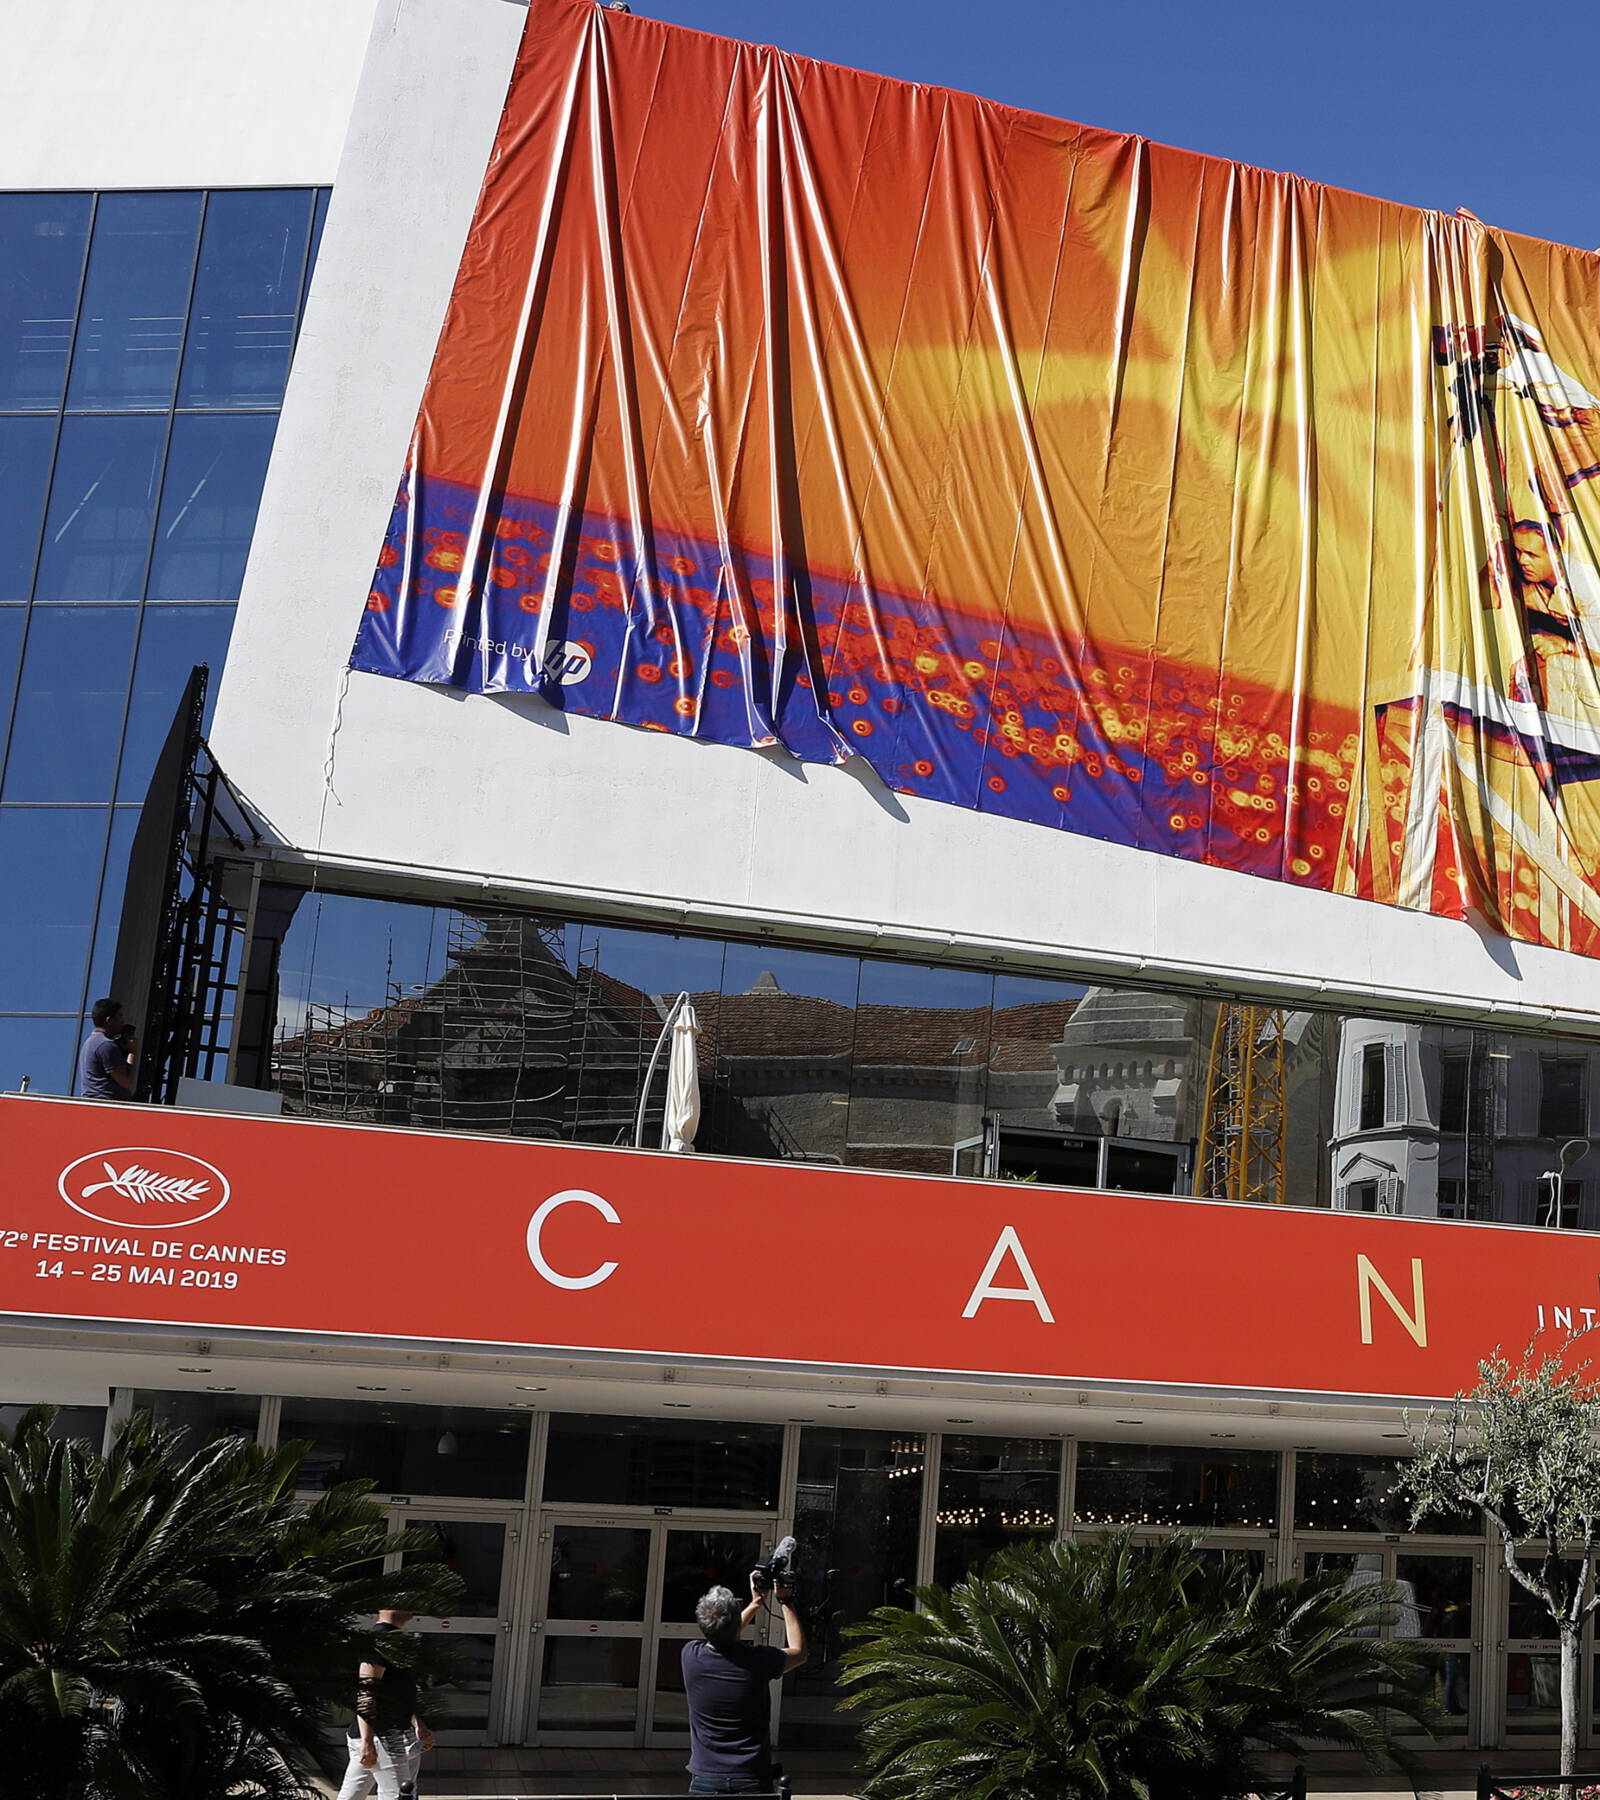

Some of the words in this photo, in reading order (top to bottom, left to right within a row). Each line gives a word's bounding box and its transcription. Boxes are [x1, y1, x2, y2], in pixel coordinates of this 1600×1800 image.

[443, 629, 507, 654] Pinted
[511, 643, 534, 661] by
[32, 1233, 146, 1257] FESTIVAL
[151, 1241, 183, 1259] DE
[189, 1243, 288, 1266] CANNES
[35, 1260, 63, 1278] 14
[91, 1263, 122, 1282] 25
[128, 1265, 174, 1285] MAI
[180, 1268, 238, 1289] 2019
